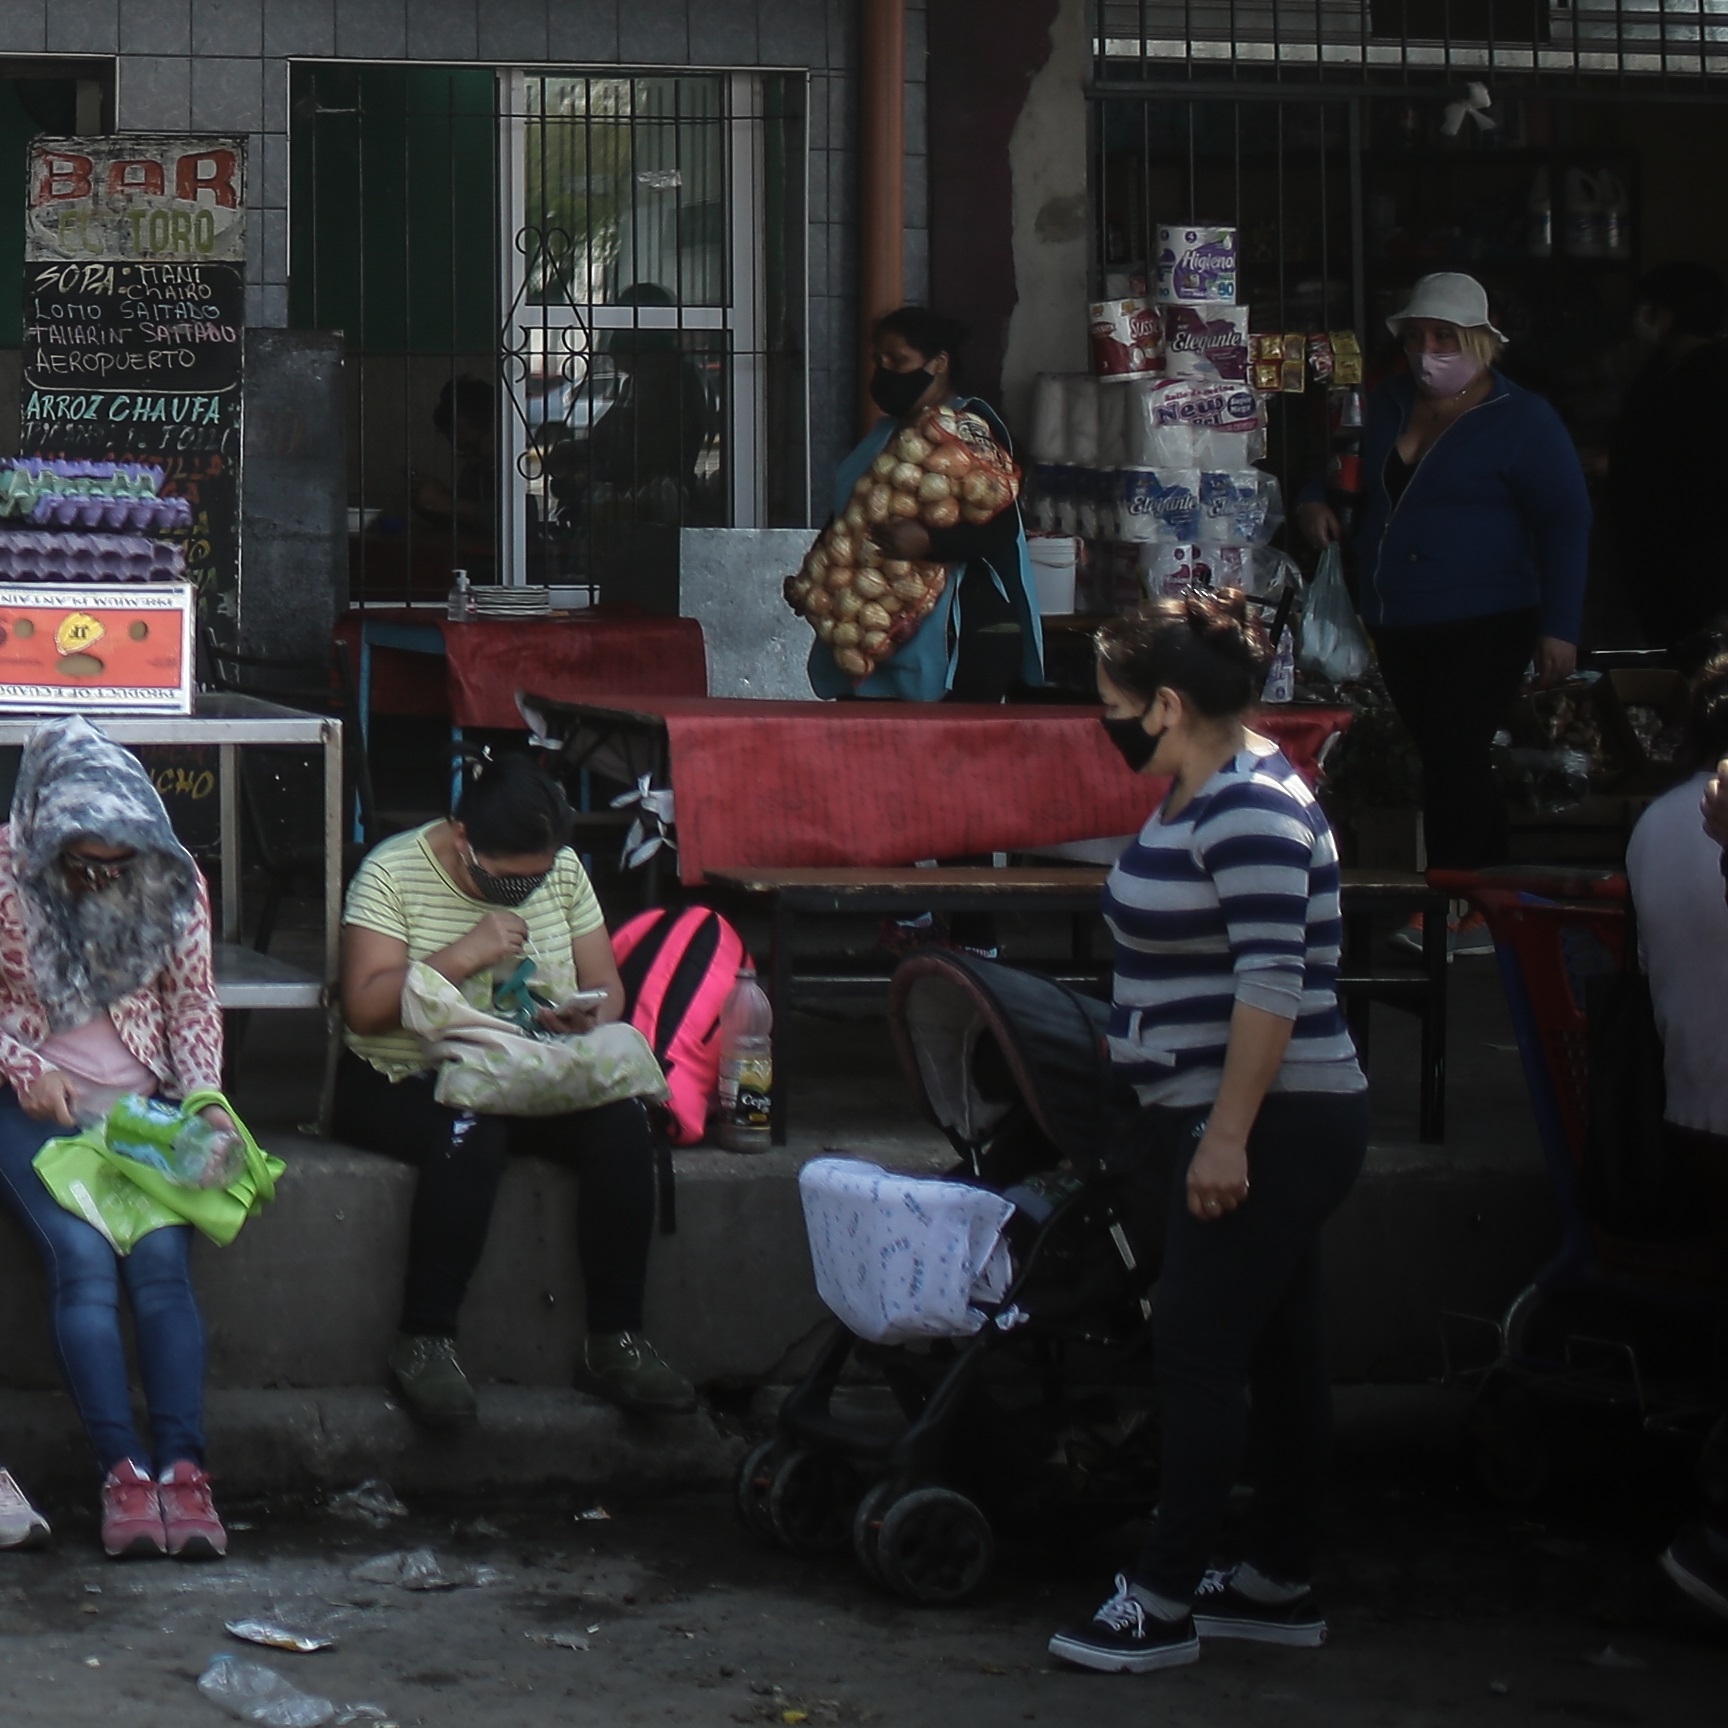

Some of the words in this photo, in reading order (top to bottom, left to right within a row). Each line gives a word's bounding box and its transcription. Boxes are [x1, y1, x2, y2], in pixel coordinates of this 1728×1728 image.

[31, 148, 238, 209] BAR
[127, 209, 214, 254] TORO
[1181, 250, 1236, 273] Higienol
[35, 298, 101, 320] LOMO
[1171, 332, 1241, 354] Elegante
[36, 348, 196, 377] AEROPUERTO
[25, 390, 105, 420] ARROZ
[108, 394, 222, 425] CHAUFA
[1158, 398, 1224, 425] New
